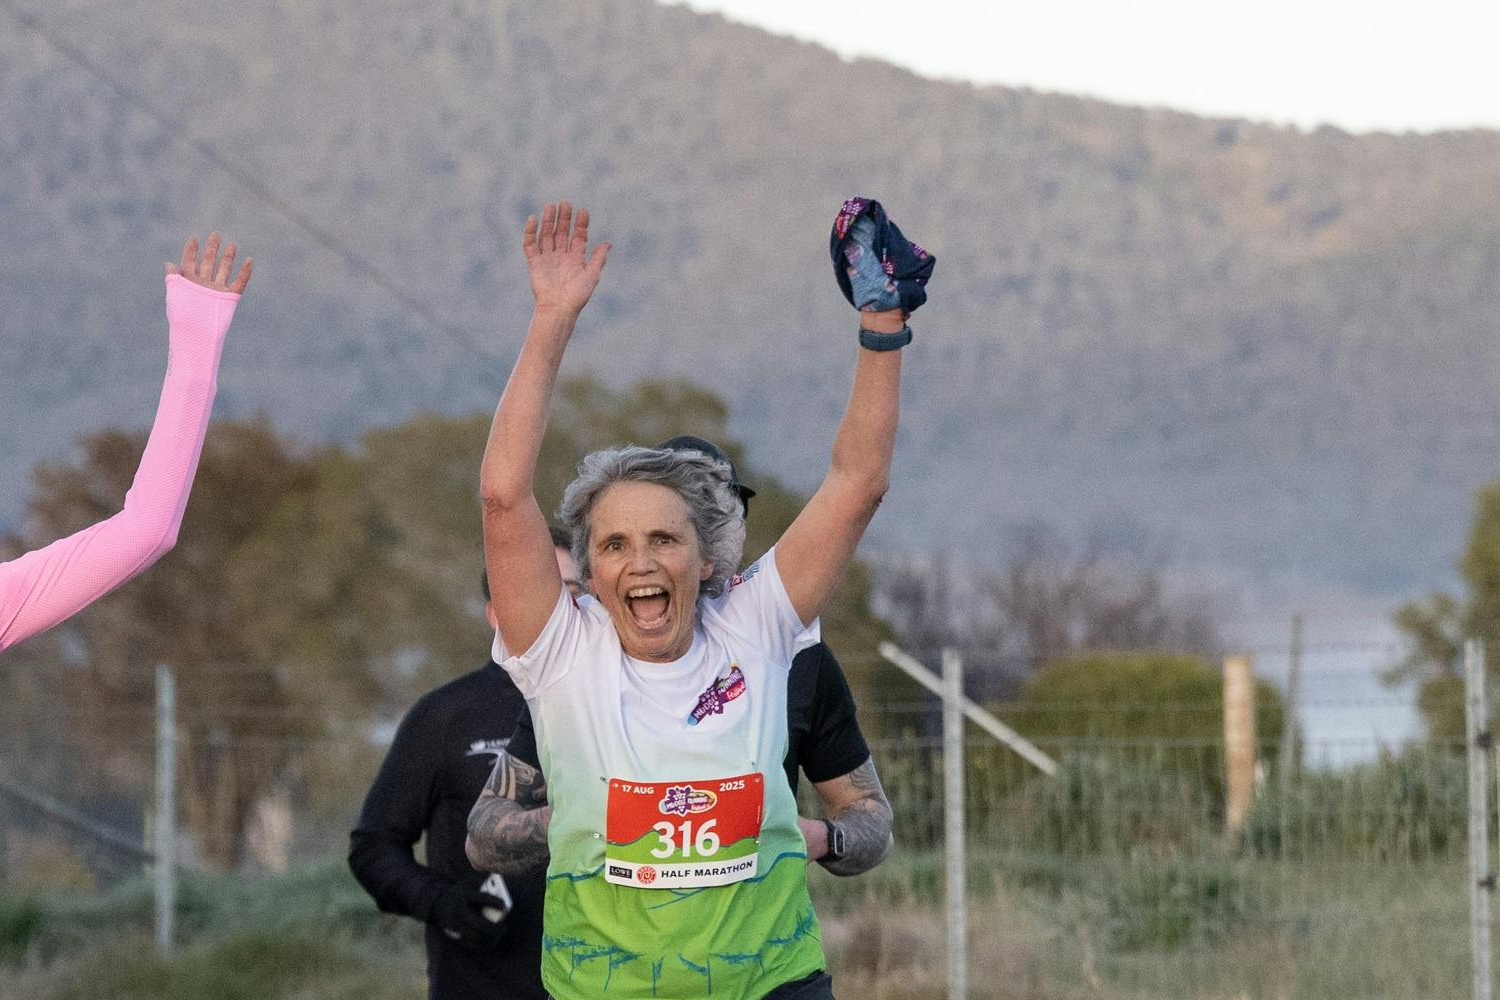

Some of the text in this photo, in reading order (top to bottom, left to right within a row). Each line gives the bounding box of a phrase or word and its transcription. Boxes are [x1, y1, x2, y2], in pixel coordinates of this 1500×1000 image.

[622, 780, 745, 795] 17 AUG 2025
[650, 818, 721, 859] 316
[661, 869, 691, 878] HALF
[694, 860, 754, 877] MARATHON
